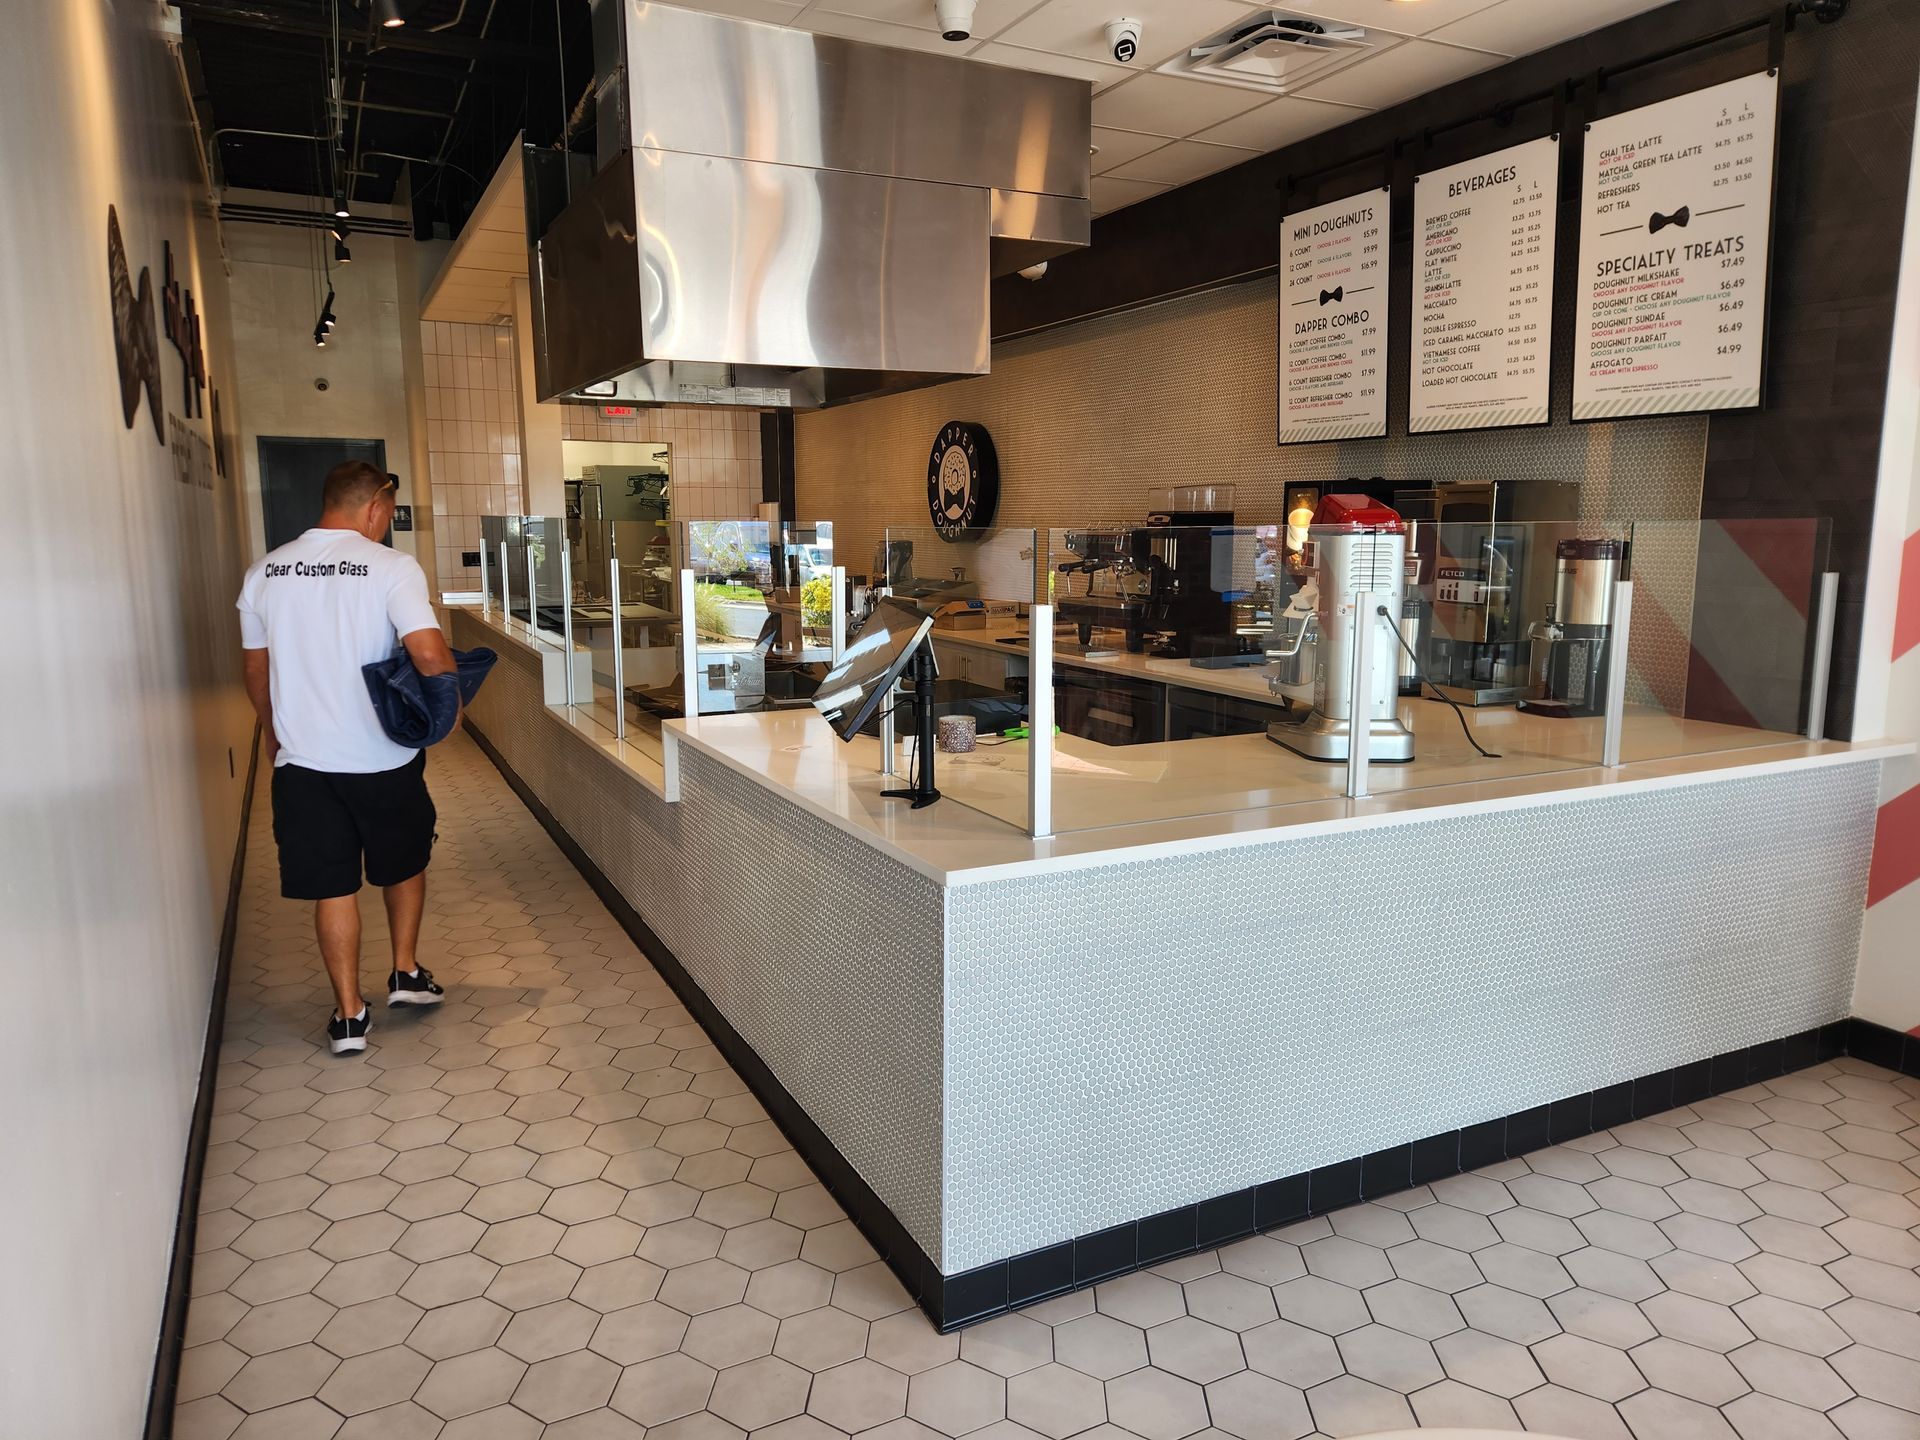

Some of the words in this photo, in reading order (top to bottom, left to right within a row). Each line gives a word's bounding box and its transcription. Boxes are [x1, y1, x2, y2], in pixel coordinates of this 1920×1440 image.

[1722, 108, 1727, 117] S
[1745, 102, 1749, 111] L
[1600, 147, 1618, 160] CHAI
[1621, 143, 1635, 154] TEA
[1639, 135, 1662, 149] LATTE
[1599, 158, 1611, 167] HOT
[1613, 155, 1621, 163] OR
[1623, 152, 1635, 160] ICED
[1599, 164, 1629, 179] MATCHA
[1633, 157, 1656, 170] GREEN
[1660, 152, 1674, 164] TEA
[1678, 145, 1702, 159] LATTE
[1449, 165, 1516, 198] BEVERAGES
[1599, 177, 1610, 186] HOT
[1612, 175, 1620, 183] OR
[1622, 171, 1633, 180] ICED
[1518, 184, 1522, 193] S
[1534, 180, 1538, 189] L
[1598, 182, 1640, 200] REFRESHERS
[1597, 203, 1613, 215] HOT
[1617, 199, 1630, 210] TEA
[1294, 226, 1310, 241] MINI
[1314, 208, 1372, 236] DOUGHNUTS
[1426, 214, 1447, 226] BREWED
[1450, 208, 1470, 220] COFFEE
[1364, 228, 1378, 238] $5.99
[1426, 227, 1458, 241] AMERICANO
[1290, 250, 1293, 258] 6
[1295, 246, 1311, 256] COUNT
[1364, 244, 1377, 254] $9.99
[1425, 242, 1462, 257] CAPPUCCINO
[1597, 248, 1675, 277] SPECIALTY
[1684, 235, 1744, 261] TREATS
[1296, 260, 1312, 271] COUNT
[1361, 260, 1377, 270] $16.99
[1425, 258, 1438, 268] FLAT
[1440, 254, 1457, 264] WHITE
[1721, 256, 1744, 268] $7.49
[1425, 267, 1442, 278] LATTE
[1594, 276, 1634, 291] DOUGHNUT
[1638, 268, 1679, 283] MILKSHAKE
[1290, 279, 1294, 287] 24
[1296, 275, 1312, 286] COUNT
[1425, 283, 1444, 293] SPANISH
[1445, 279, 1461, 289] LATTE
[1593, 289, 1615, 298] CHOOSE
[1630, 282, 1659, 292] DOUGHNUT
[1661, 277, 1684, 287] FLAVOR
[1721, 278, 1744, 290] $6.49
[1424, 298, 1457, 310] MACCHIATO
[1592, 310, 1602, 318] CUP
[1613, 307, 1628, 315] CONE
[1634, 302, 1657, 312] CHOOSE
[1660, 300, 1671, 308] ANY
[1673, 295, 1704, 306] DOUGHNUT
[1706, 291, 1731, 301] FLAVOR
[1593, 296, 1633, 310] DOUGHNUT
[1637, 294, 1648, 304] ICE
[1651, 289, 1677, 301] CREAM
[1720, 300, 1743, 312] $6.49
[1296, 318, 1327, 334] DAPPER
[1332, 310, 1369, 328] COMBO
[1424, 312, 1445, 322] MOCHA
[1592, 317, 1632, 330] DOUGHNUT
[1636, 312, 1665, 324] SUNDAE
[1362, 327, 1376, 336] $7.99
[1424, 325, 1446, 335] DOUBLE
[1448, 319, 1476, 331] ESPRESSO
[1592, 329, 1613, 338] CHOOSE
[1628, 323, 1657, 333] DOUGHNUT
[1659, 320, 1682, 328] FLAVOR
[1718, 322, 1742, 333] $6.49
[1294, 340, 1308, 348] COUNT
[1310, 336, 1326, 345] COFFEE
[1328, 333, 1345, 342] COMBO
[1423, 338, 1436, 347] ICED
[1438, 334, 1464, 344] CARAMEL
[1466, 328, 1504, 340] MACCHIATO
[1591, 337, 1631, 350] DOUGHNUT
[1635, 333, 1666, 344] PARFAIT
[1361, 348, 1376, 356] $11.99
[1424, 348, 1456, 359] VIETNAMESE
[1459, 344, 1480, 354] COFFEE
[1591, 348, 1612, 357] CHOOSE
[1627, 344, 1656, 353] DOUGHNUT
[1658, 341, 1681, 349] FLAVOR
[1717, 344, 1741, 355] $4.99
[1294, 359, 1309, 367] COUNT
[1311, 356, 1327, 364] COFFEE
[1328, 353, 1346, 361] COMBO
[1591, 357, 1633, 369] AFFOGATO
[1362, 368, 1375, 377] $7.99
[1422, 367, 1434, 375] HOT
[1437, 362, 1473, 373] CHOCOLATE
[1632, 364, 1658, 372] ESPRESSO
[1310, 375, 1332, 383] REFRESHER
[1334, 372, 1352, 380] COMBO
[1422, 378, 1444, 387] LOADED
[1446, 376, 1458, 384] HOT
[1461, 372, 1497, 383] CHOCOLATE
[1310, 394, 1333, 402] REFRESHER
[1335, 392, 1352, 400] COMBO
[1361, 388, 1375, 397] $11.99
[934, 427, 974, 464] DAPPER
[932, 496, 976, 538] DOUGHNUT
[265, 563, 291, 578] Clear
[295, 561, 335, 577] Custom
[338, 560, 368, 576] Glass
